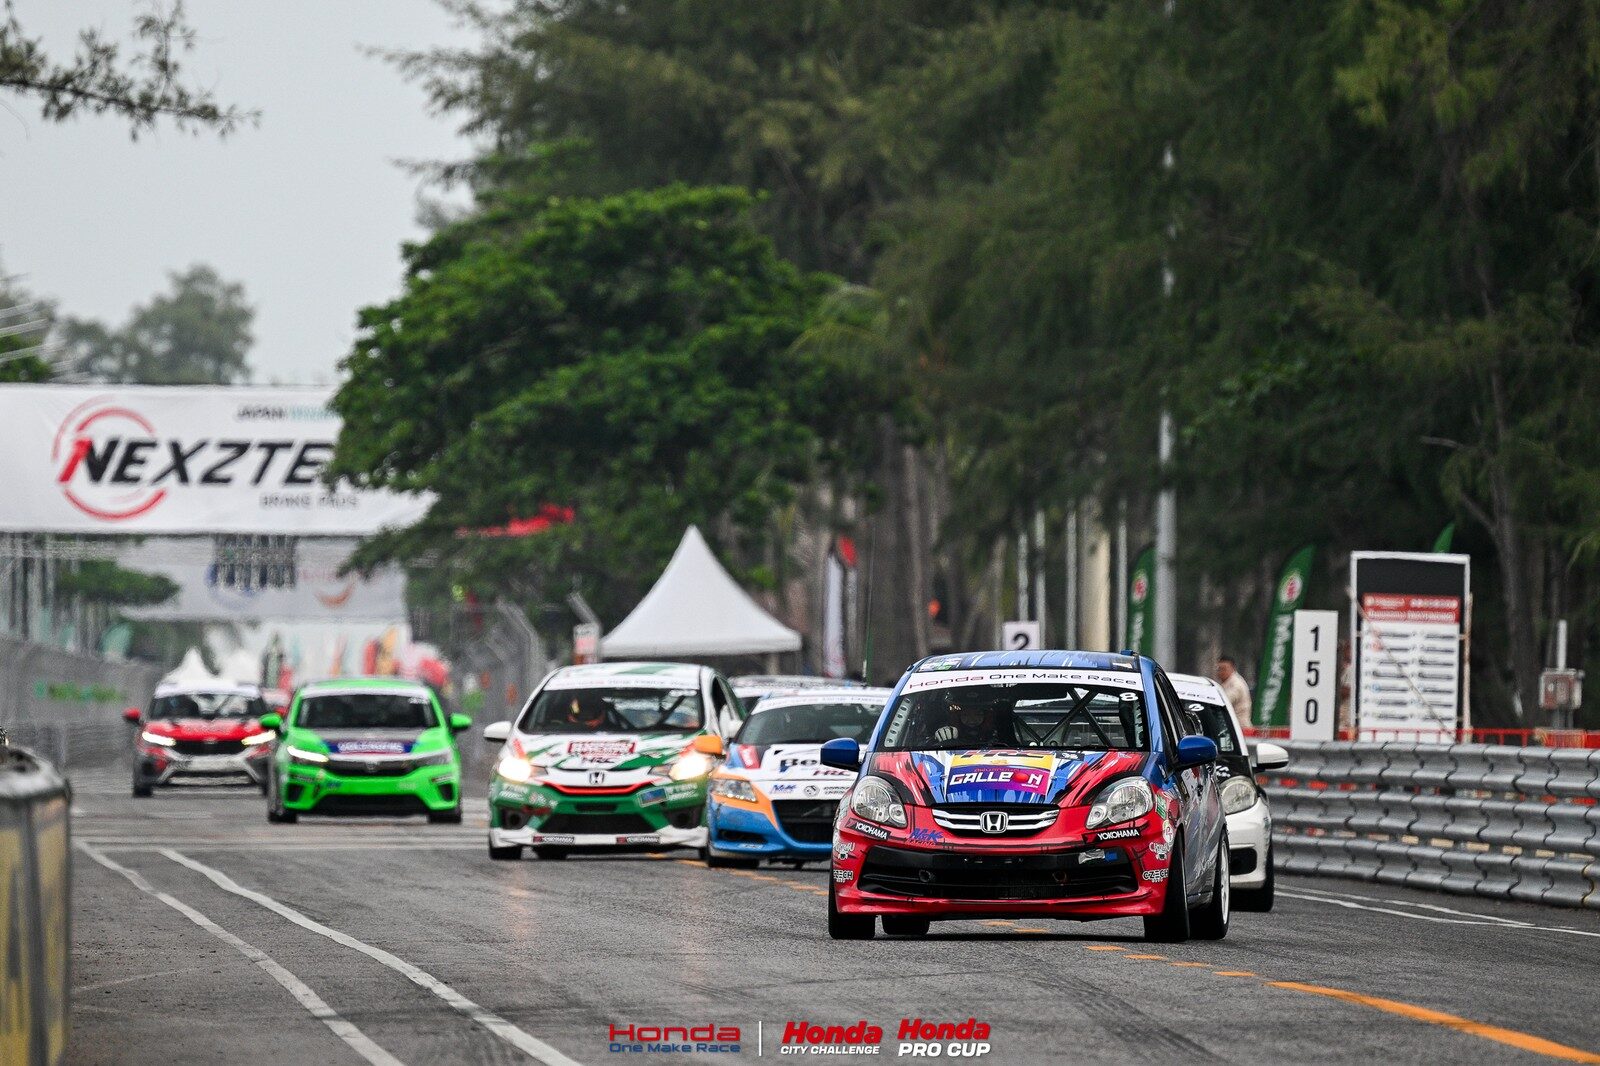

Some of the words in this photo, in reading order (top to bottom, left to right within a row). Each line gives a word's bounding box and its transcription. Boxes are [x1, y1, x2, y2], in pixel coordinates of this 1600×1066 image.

[58, 439, 336, 485] NEXZTE
[909, 674, 984, 689] Honda
[989, 672, 1027, 680] One
[1087, 673, 1137, 685] Race
[855, 821, 888, 840] YOKOHAMA
[1097, 828, 1140, 841] YOKOHAMA
